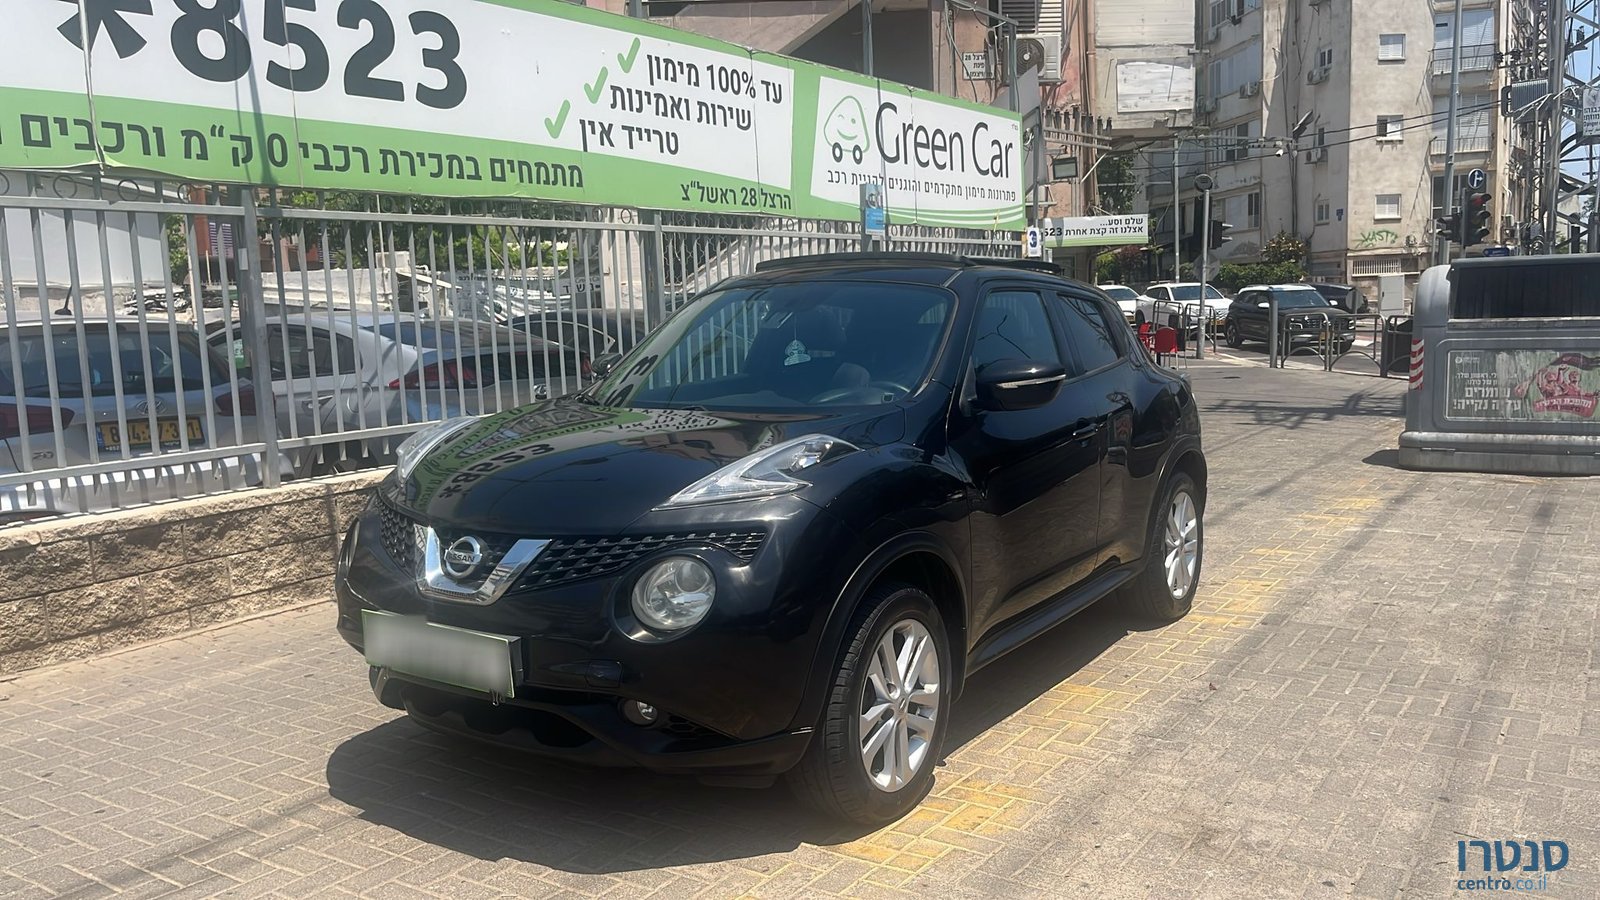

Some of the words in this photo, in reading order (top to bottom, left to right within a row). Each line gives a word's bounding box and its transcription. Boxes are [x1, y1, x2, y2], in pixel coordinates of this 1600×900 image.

[647, 54, 700, 88] מימון
[706, 64, 756, 99] 100%
[610, 84, 691, 121] ואמינות
[760, 79, 783, 104] עד
[697, 100, 751, 131] שירות
[20, 113, 166, 158] ורכבים
[267, 132, 289, 168] 0
[579, 118, 615, 152] אין
[621, 124, 679, 156] טרייד
[875, 101, 965, 173] Green
[972, 121, 1013, 179] Car
[298, 142, 370, 173] רכבי
[379, 148, 482, 181] במכירת
[489, 157, 584, 188] מתמחים
[828, 169, 847, 184] רכב
[888, 177, 921, 192] והוגנים
[924, 181, 963, 198] מתקדמים
[740, 187, 757, 206] 28
[760, 187, 792, 209] הרצל
[965, 185, 986, 200] מימון
[988, 188, 1016, 202] פתרונות
[1065, 227, 1087, 236] אחרת
[1090, 227, 1107, 236] קצת
[1125, 217, 1143, 225] שלם
